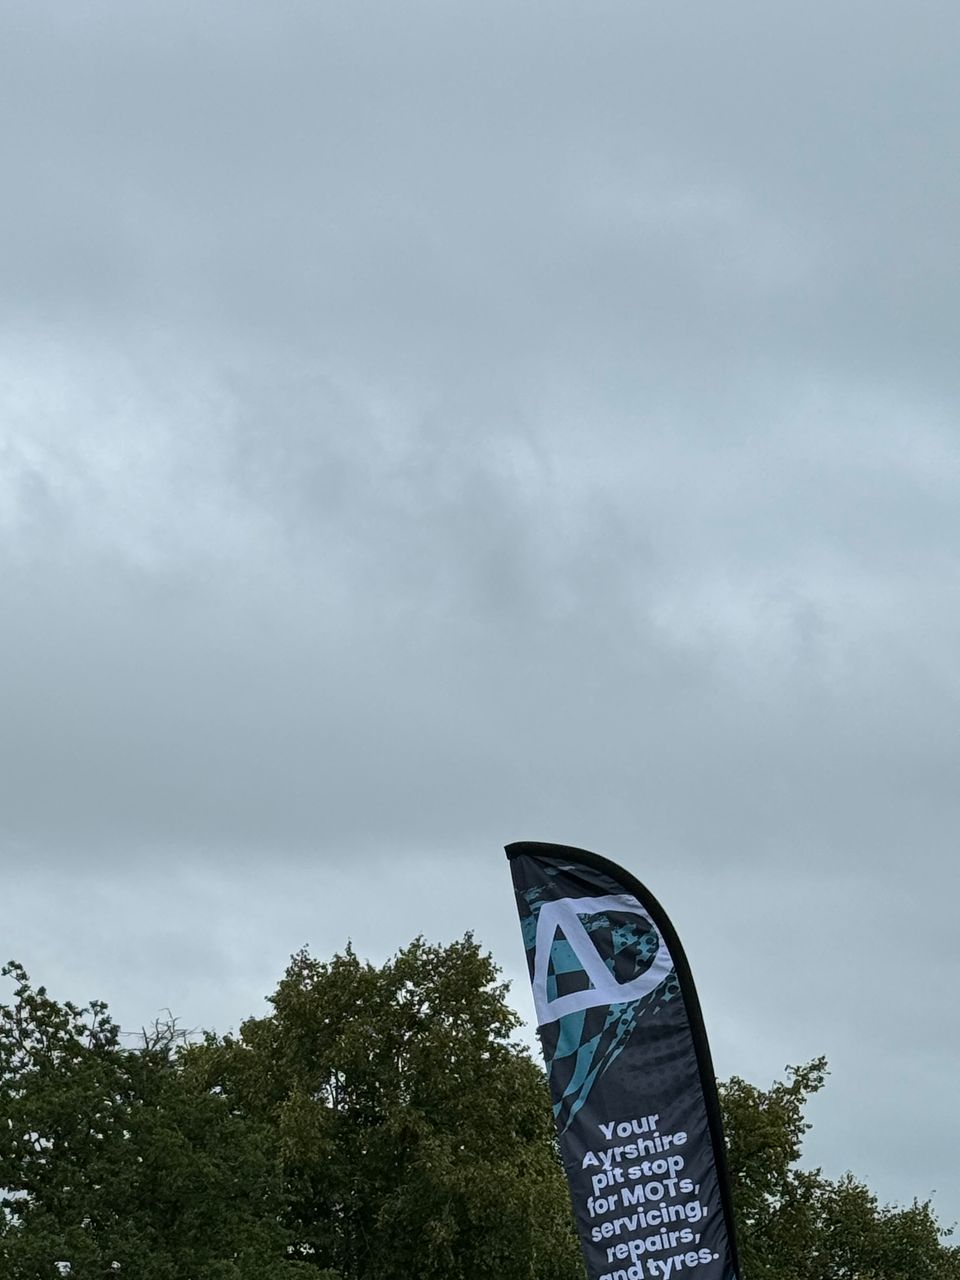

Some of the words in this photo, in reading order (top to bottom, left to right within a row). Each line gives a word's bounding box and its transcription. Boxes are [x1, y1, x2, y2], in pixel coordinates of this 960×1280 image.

[598, 1113, 660, 1140] Your
[582, 1131, 688, 1170] Ayrshire
[591, 1166, 625, 1196] pit
[628, 1155, 685, 1180] stop
[587, 1194, 619, 1218] for
[621, 1177, 701, 1207] MOTs,
[591, 1200, 708, 1243] servicing,
[606, 1227, 701, 1263] repairs,
[646, 1247, 720, 1280] tyres.
